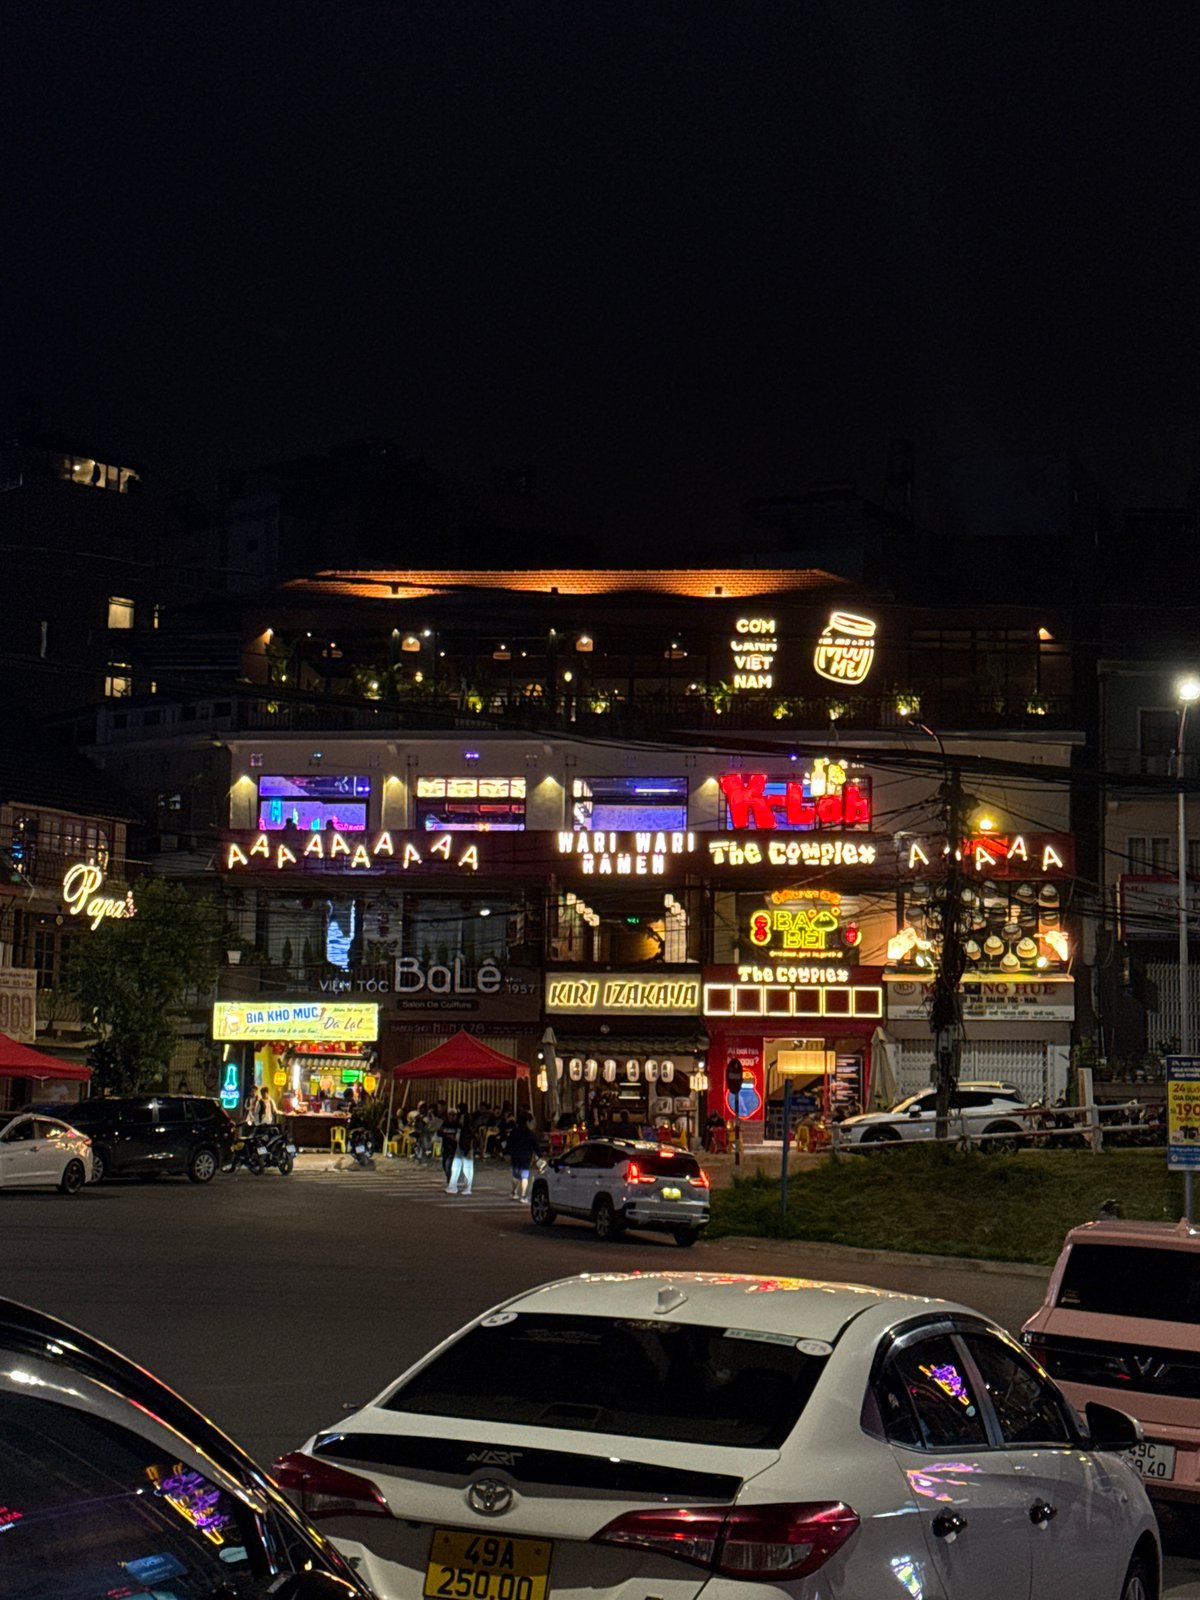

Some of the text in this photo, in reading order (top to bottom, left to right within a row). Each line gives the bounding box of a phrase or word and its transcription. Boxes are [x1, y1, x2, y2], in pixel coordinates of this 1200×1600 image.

[733, 674, 773, 689] NAM
[558, 832, 695, 853] WARI WARI
[708, 840, 877, 866] The Complex
[582, 853, 665, 875] RAMEN
[738, 966, 849, 983] The Complex
[357, 977, 390, 993] TÓC
[508, 983, 536, 995] 1957
[548, 979, 699, 1008] KIRI IZAKAYA
[246, 1011, 265, 1024] BIA
[1128, 1443, 1157, 1459] 49C
[464, 1536, 515, 1569] 49A
[437, 1566, 533, 1600] 250.00
